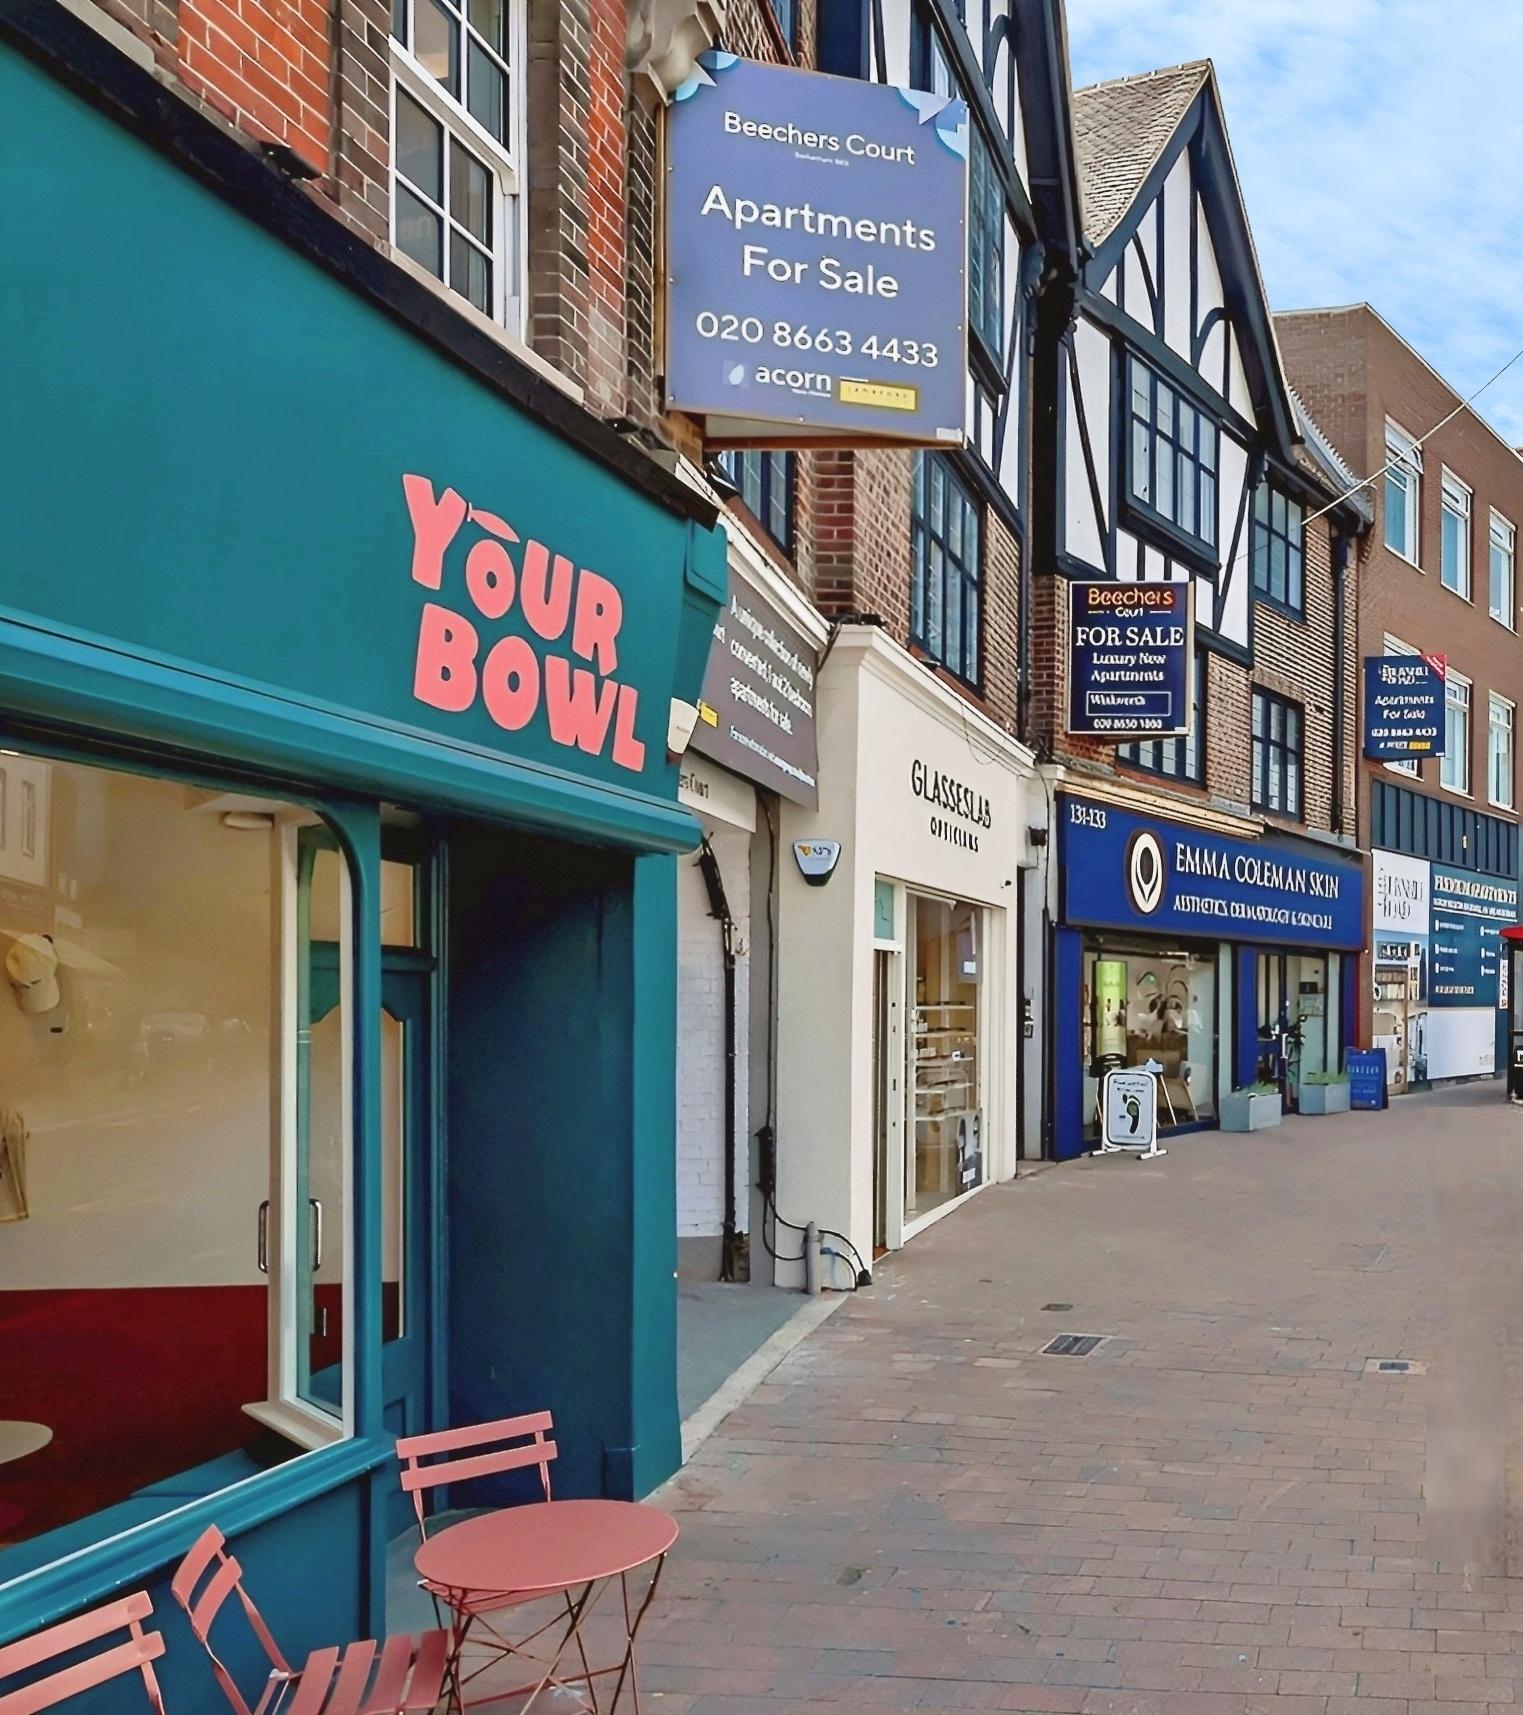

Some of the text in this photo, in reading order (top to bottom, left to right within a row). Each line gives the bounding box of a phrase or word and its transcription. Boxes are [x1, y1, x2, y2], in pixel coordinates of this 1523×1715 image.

[724, 111, 840, 152] Beechers
[846, 133, 915, 166] Court
[700, 184, 936, 252] Apartments
[743, 244, 900, 298] For Sale
[695, 311, 938, 368] 020 8663 4433
[755, 364, 832, 392] acorn
[402, 473, 623, 677] YOUR
[1075, 626, 1185, 647] FOR SALE
[413, 602, 646, 773] BOWL
[911, 759, 992, 829] GLASSESLAB
[1176, 842, 1231, 881] EMMA
[1234, 855, 1306, 894] COLEMAN
[1309, 871, 1339, 899] SKIN
